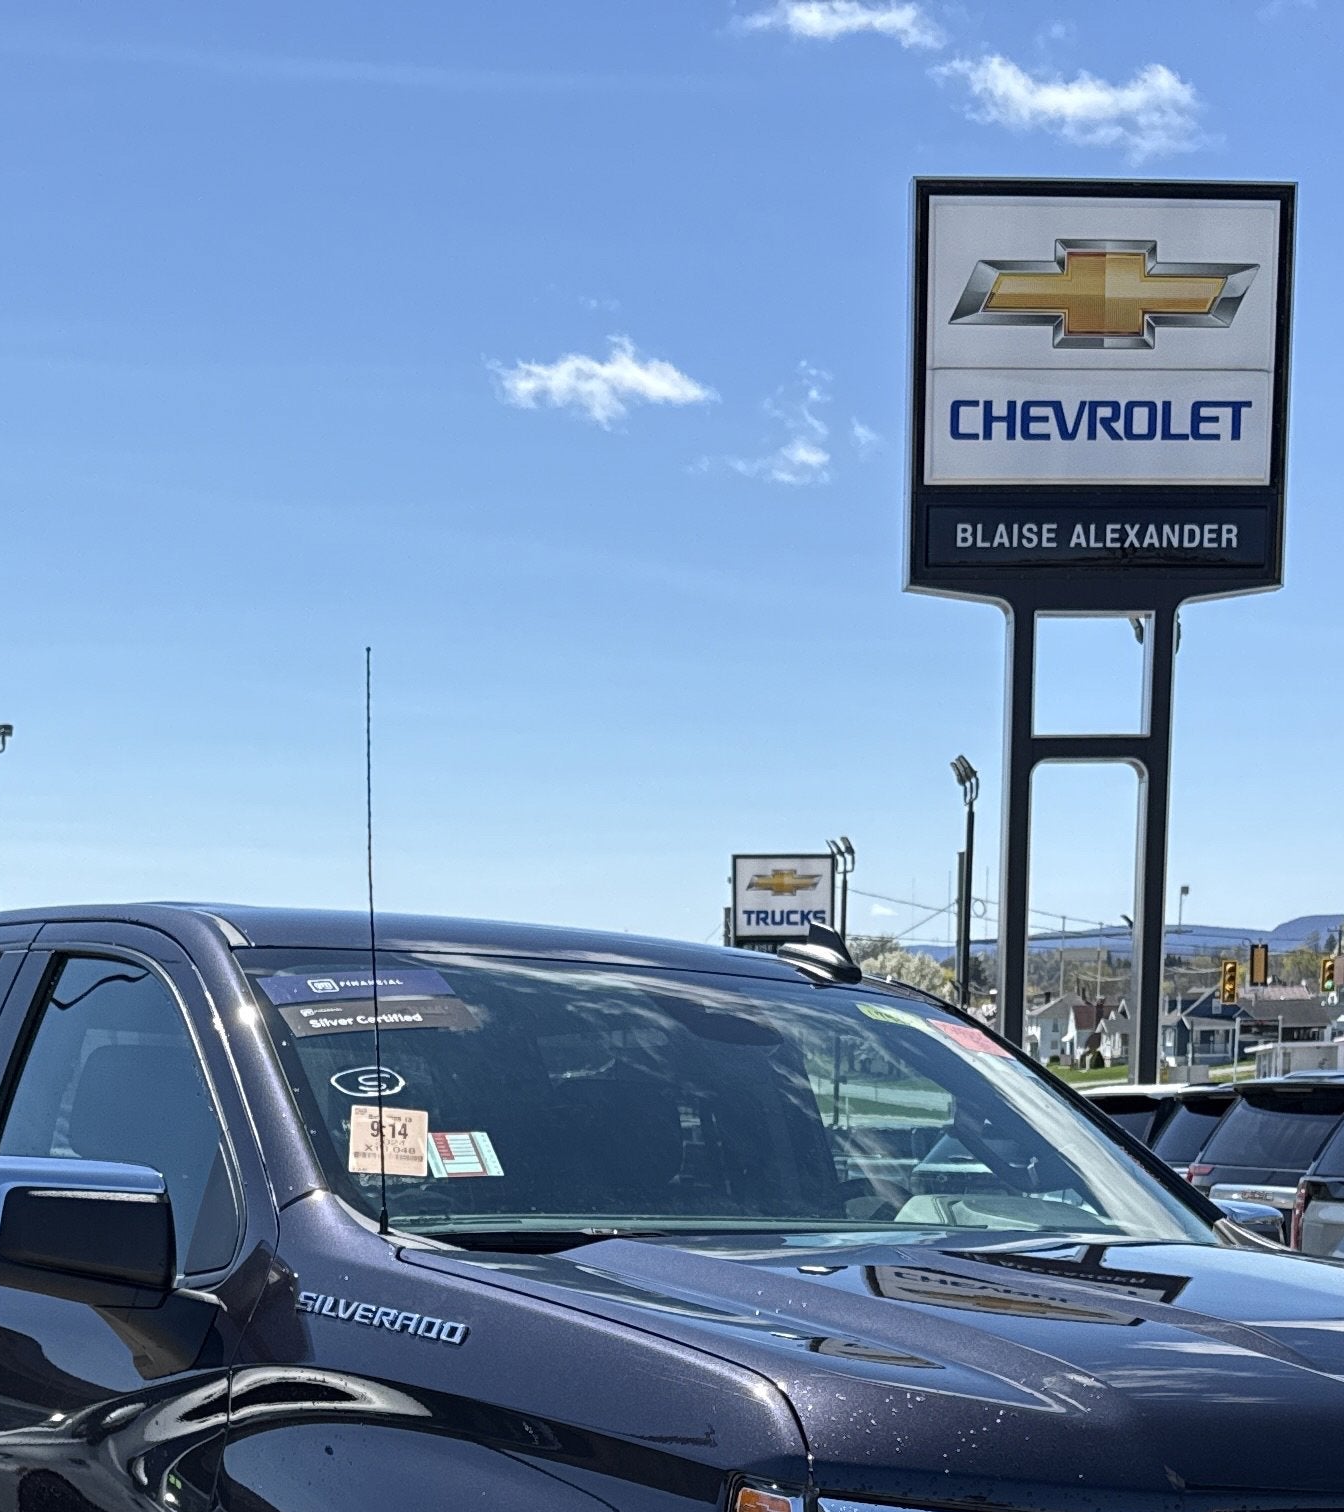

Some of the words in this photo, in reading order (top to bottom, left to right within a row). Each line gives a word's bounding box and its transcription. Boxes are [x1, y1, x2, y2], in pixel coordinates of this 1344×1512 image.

[949, 398, 1253, 442] CHEVROLET
[955, 522, 1058, 549] BLAISE
[1068, 522, 1239, 549] ALEXANDER
[742, 910, 826, 926] TRUCKS
[308, 1016, 354, 1028] Silver
[356, 1012, 424, 1025] Certified
[296, 1291, 470, 1345] SILVERADO
